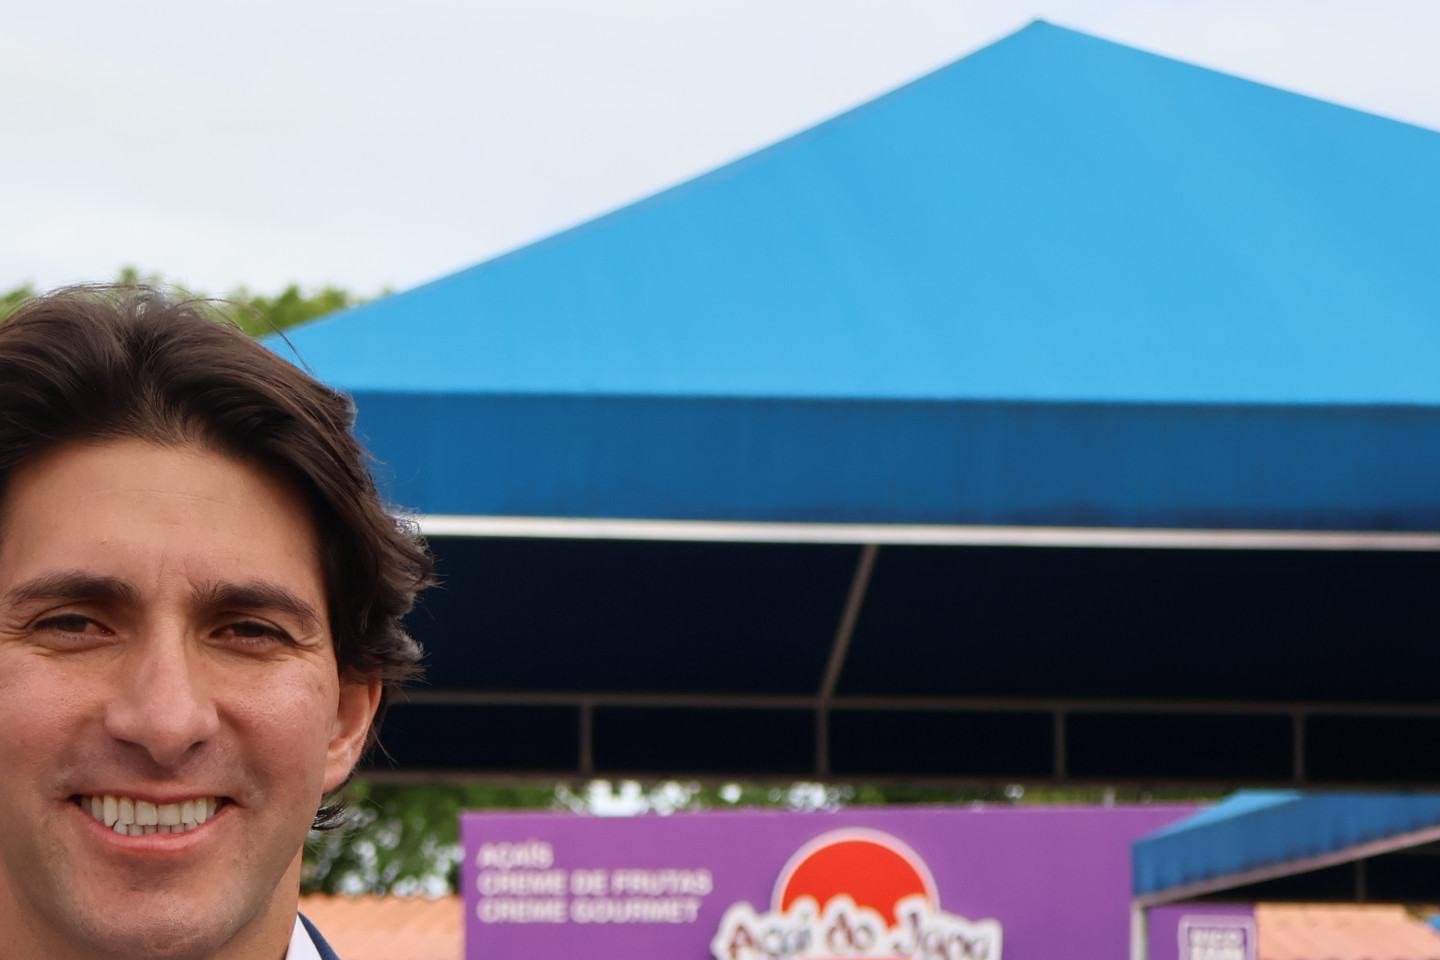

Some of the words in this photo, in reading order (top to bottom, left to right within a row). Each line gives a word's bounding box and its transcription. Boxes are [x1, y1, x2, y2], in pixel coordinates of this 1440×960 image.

[477, 870, 567, 895] CREME
[571, 870, 608, 895] DE
[611, 870, 712, 895] FRUTAS
[477, 898, 567, 923] CREME
[570, 898, 700, 923] GOURMET
